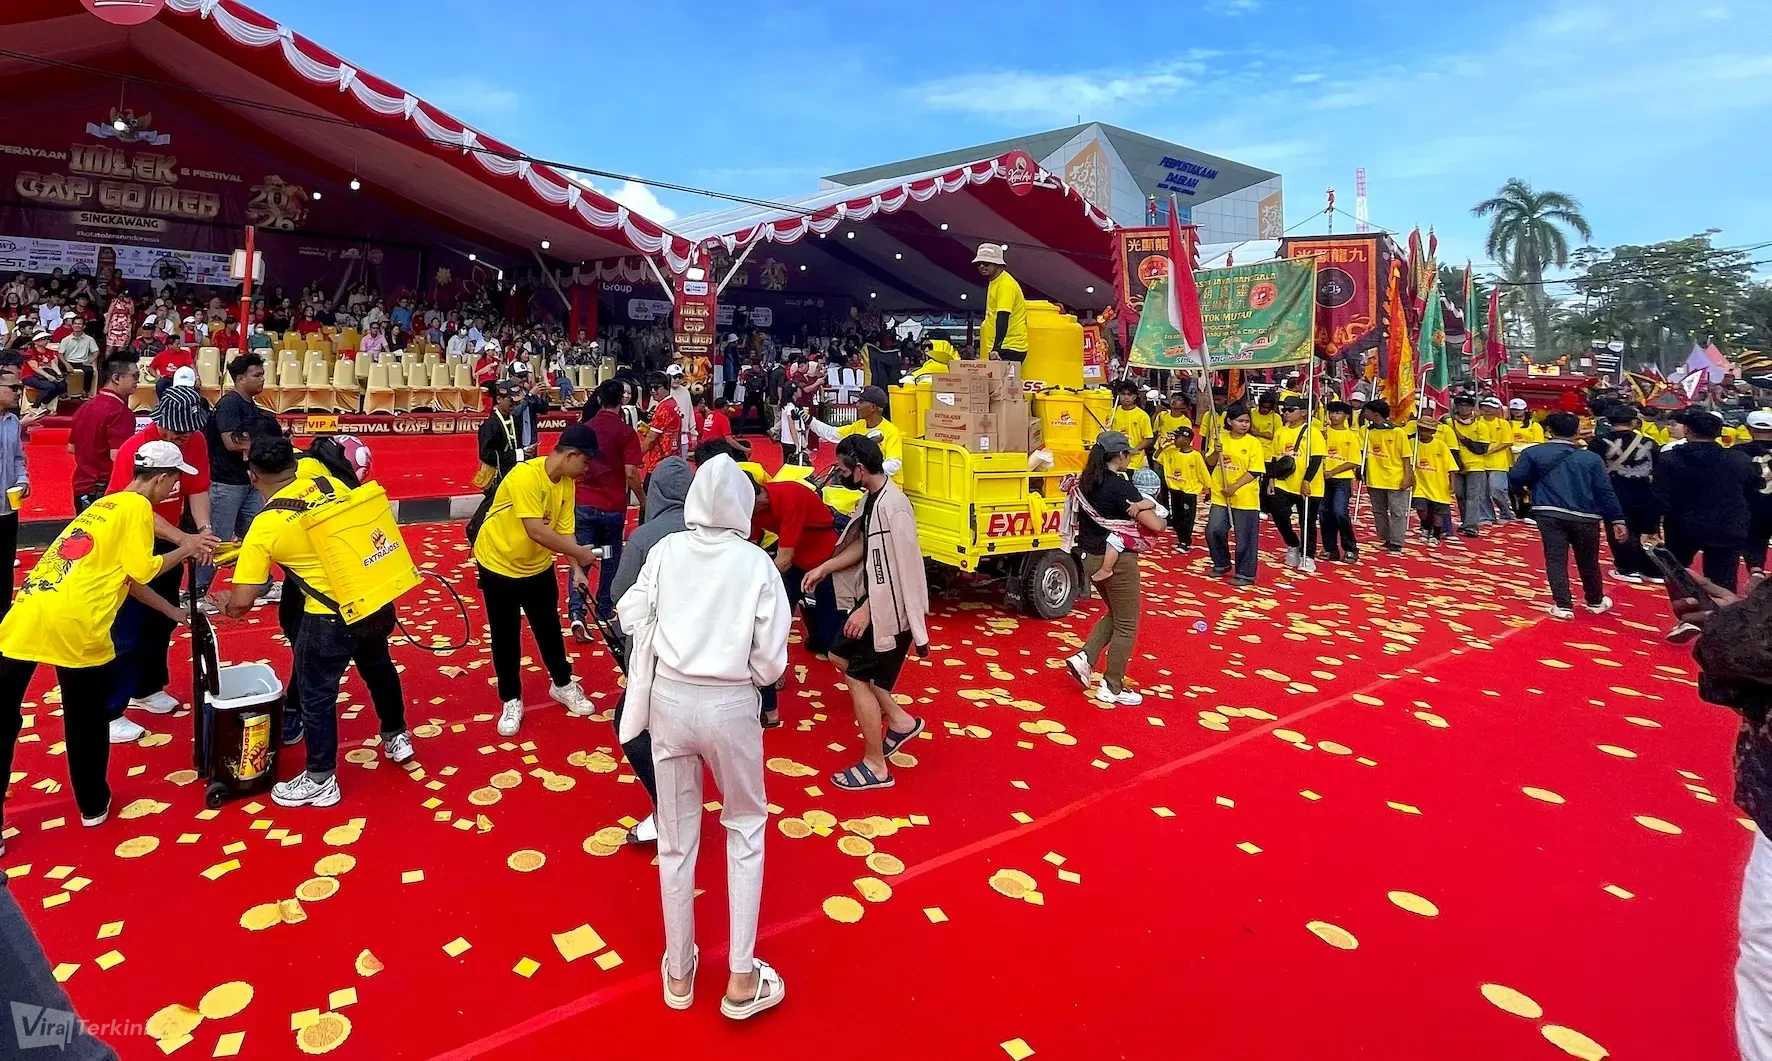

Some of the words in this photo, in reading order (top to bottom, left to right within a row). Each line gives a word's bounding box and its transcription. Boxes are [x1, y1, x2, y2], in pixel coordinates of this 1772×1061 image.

[69, 143, 178, 185] IMLEK
[180, 167, 190, 176] &
[193, 169, 243, 183] FESTIVAL
[15, 171, 93, 204] CAP
[99, 181, 147, 213] GO
[148, 186, 220, 219] MEH
[80, 212, 159, 228] SINGKAWANG
[308, 420, 326, 428] VIP
[329, 420, 338, 428] A
[392, 419, 430, 433] CAP
[432, 420, 455, 434] GO
